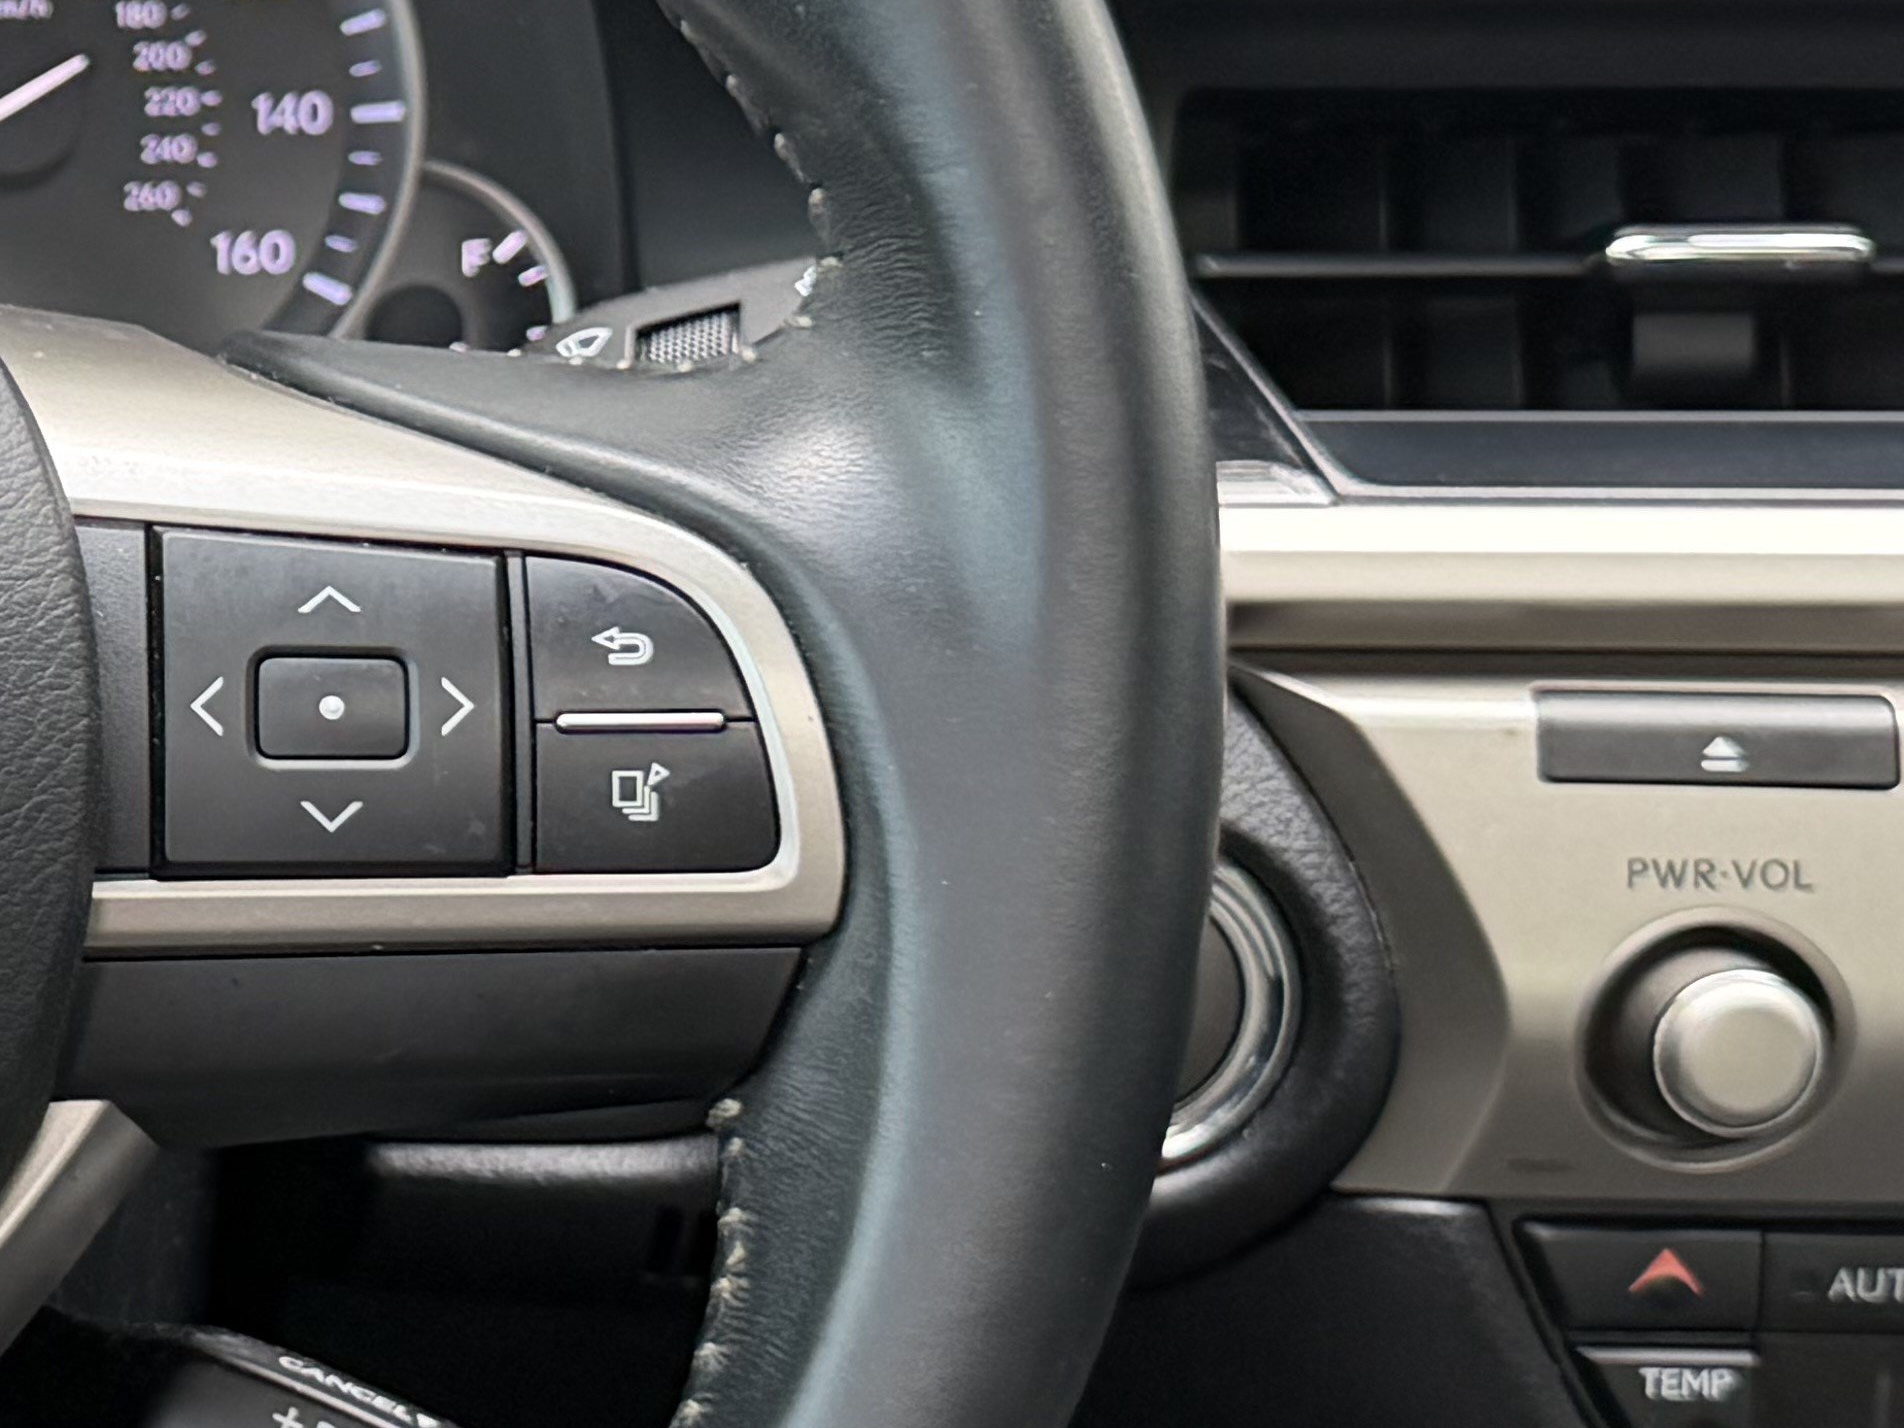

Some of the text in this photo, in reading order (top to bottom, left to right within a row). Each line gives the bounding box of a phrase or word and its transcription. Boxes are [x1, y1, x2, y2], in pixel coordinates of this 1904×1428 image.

[115, 0, 168, 29] 180
[133, 40, 192, 71] 200
[144, 86, 201, 117] 220
[251, 91, 334, 136] 140
[140, 133, 198, 165] 240
[123, 180, 182, 212] 260
[211, 230, 295, 277] 160
[461, 238, 492, 277] F
[1639, 1366, 1733, 1401] TEMP
